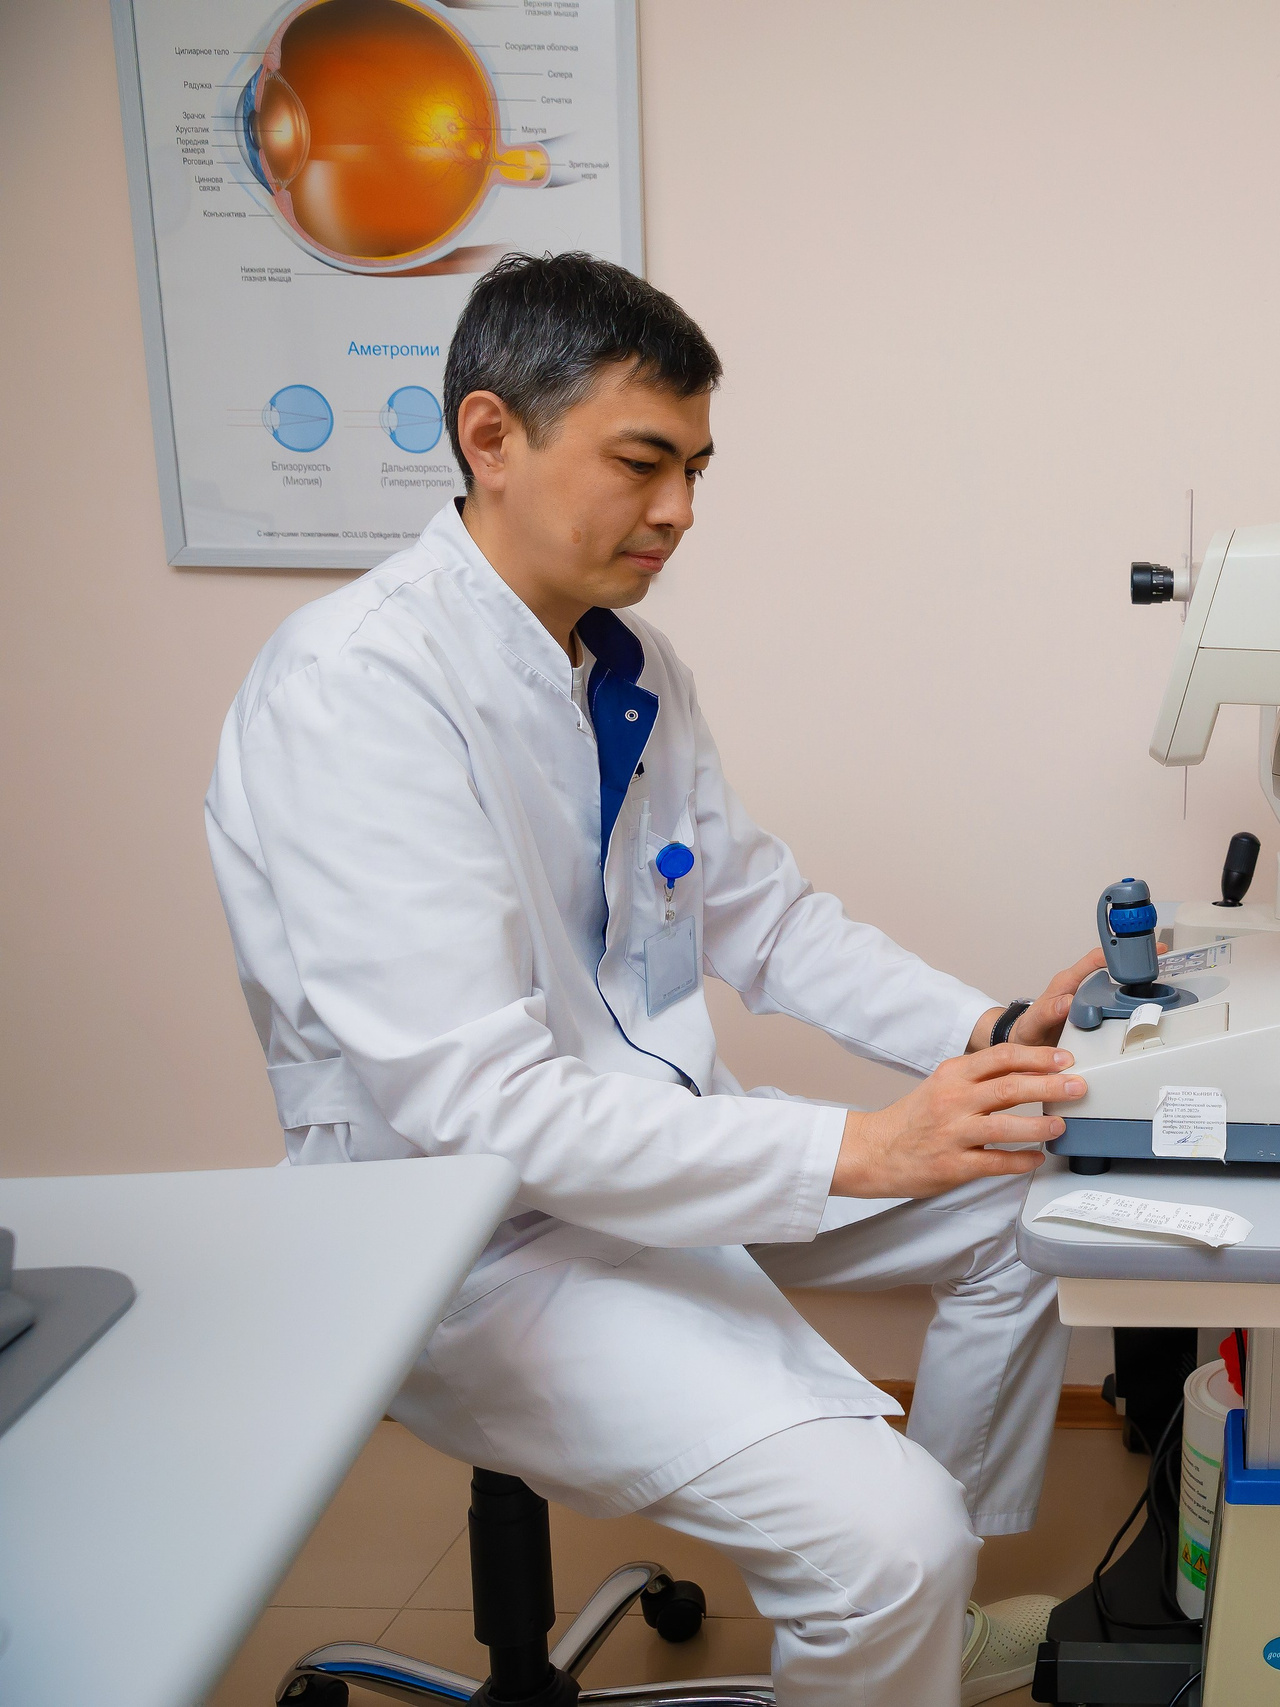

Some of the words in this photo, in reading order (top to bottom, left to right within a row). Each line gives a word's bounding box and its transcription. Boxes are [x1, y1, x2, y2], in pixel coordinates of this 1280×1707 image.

[174, 47, 212, 56] Цилиарное
[504, 42, 545, 52] Сосудистая
[546, 43, 579, 52] оболочка
[547, 70, 573, 79] Склера
[183, 81, 212, 90] Радужка
[541, 96, 573, 104] Сетчатка
[182, 111, 206, 120] Зрачок
[175, 125, 210, 134] Хрусталик
[521, 126, 547, 135] Макула
[176, 138, 209, 146] Передняя
[182, 157, 214, 166] Роговица
[569, 160, 610, 169] Зрительный
[194, 175, 224, 184] Циннова
[203, 210, 247, 218] Конъюнктива
[347, 341, 440, 360] Аметропии
[271, 461, 331, 473] Близорукость
[381, 463, 452, 475] Дальнозоркость
[282, 477, 322, 488] (Миопия)
[380, 477, 455, 489] (Гиперметропия)
